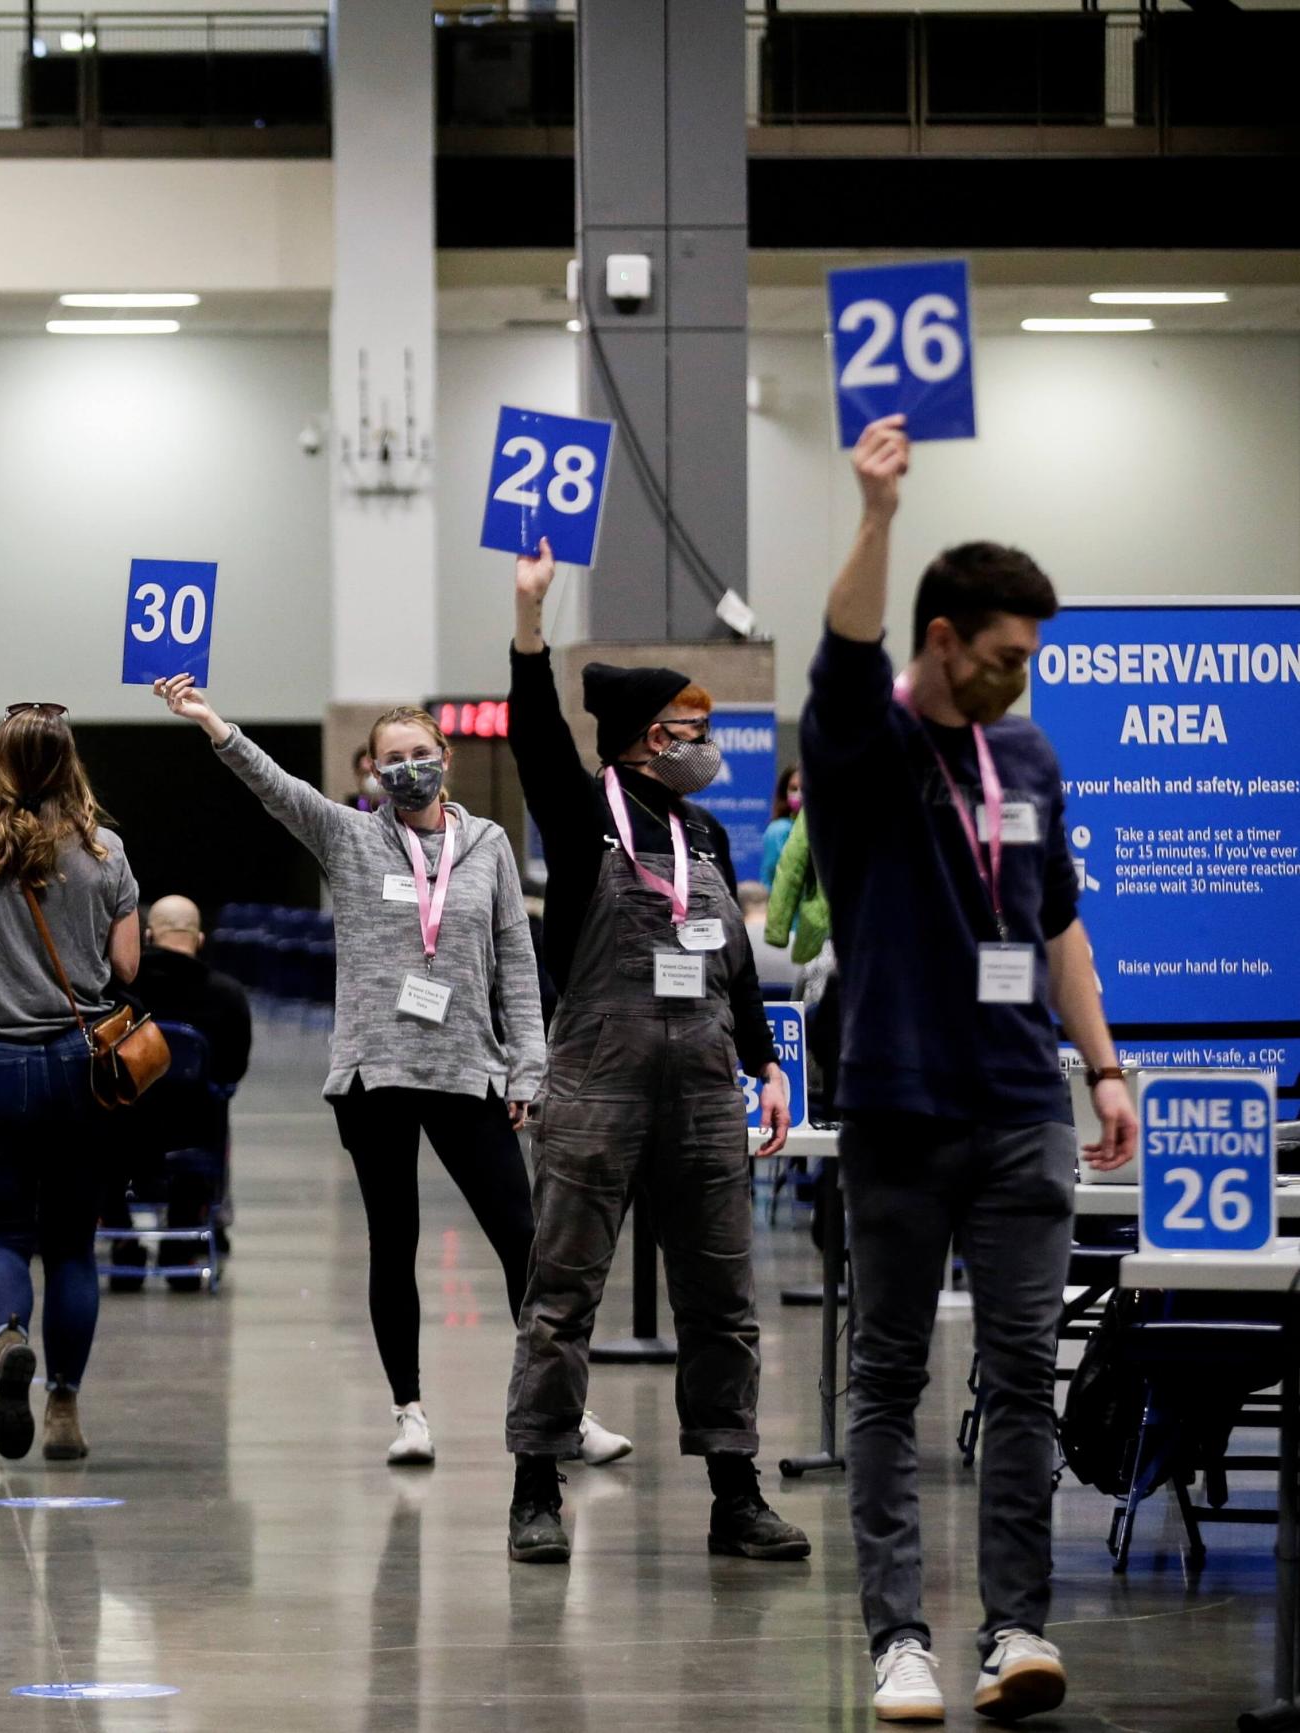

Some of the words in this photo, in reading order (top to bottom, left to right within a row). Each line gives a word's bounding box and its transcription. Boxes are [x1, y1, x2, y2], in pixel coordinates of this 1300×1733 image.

[838, 294, 963, 388] 26
[493, 436, 596, 514] 28
[131, 583, 206, 644] 30
[1038, 643, 1300, 684] OBSERVATION
[1120, 705, 1228, 745] AREA
[1076, 779, 1110, 797] your
[1113, 776, 1161, 794] health
[1164, 776, 1192, 793] and
[1195, 776, 1244, 796] safety,
[1248, 776, 1300, 797] please:
[1115, 827, 1144, 841] Take
[1147, 830, 1155, 841] a
[1158, 828, 1184, 841] seat
[1187, 826, 1211, 840] and
[1214, 828, 1233, 840] set
[1236, 830, 1244, 841] a
[1247, 827, 1281, 841] timer
[1115, 844, 1134, 859] for
[1138, 845, 1153, 859] 15
[1156, 844, 1210, 859] minutes.
[1214, 844, 1225, 858] If
[1270, 847, 1298, 858] ever
[1115, 862, 1193, 878] experienced
[1196, 865, 1204, 876] a
[1207, 865, 1248, 876] severe
[1115, 879, 1157, 896] please
[1160, 879, 1187, 893] wait
[1190, 879, 1206, 893] 30
[1210, 879, 1264, 893] minutes.
[1118, 959, 1151, 975] Raise
[1154, 962, 1182, 977] your
[1186, 959, 1217, 974] hand
[1220, 958, 1238, 973] for
[1241, 958, 1273, 977] help.
[783, 1020, 800, 1041] B
[1118, 1049, 1170, 1067] Register
[1172, 1048, 1200, 1064] with
[1203, 1049, 1245, 1066] V-safe,
[1248, 1052, 1256, 1063] a
[1259, 1048, 1286, 1063] CDC
[1147, 1098, 1233, 1128] LINE
[1241, 1099, 1267, 1128] B
[1148, 1131, 1265, 1157] STATION
[1163, 1167, 1253, 1232] 26
